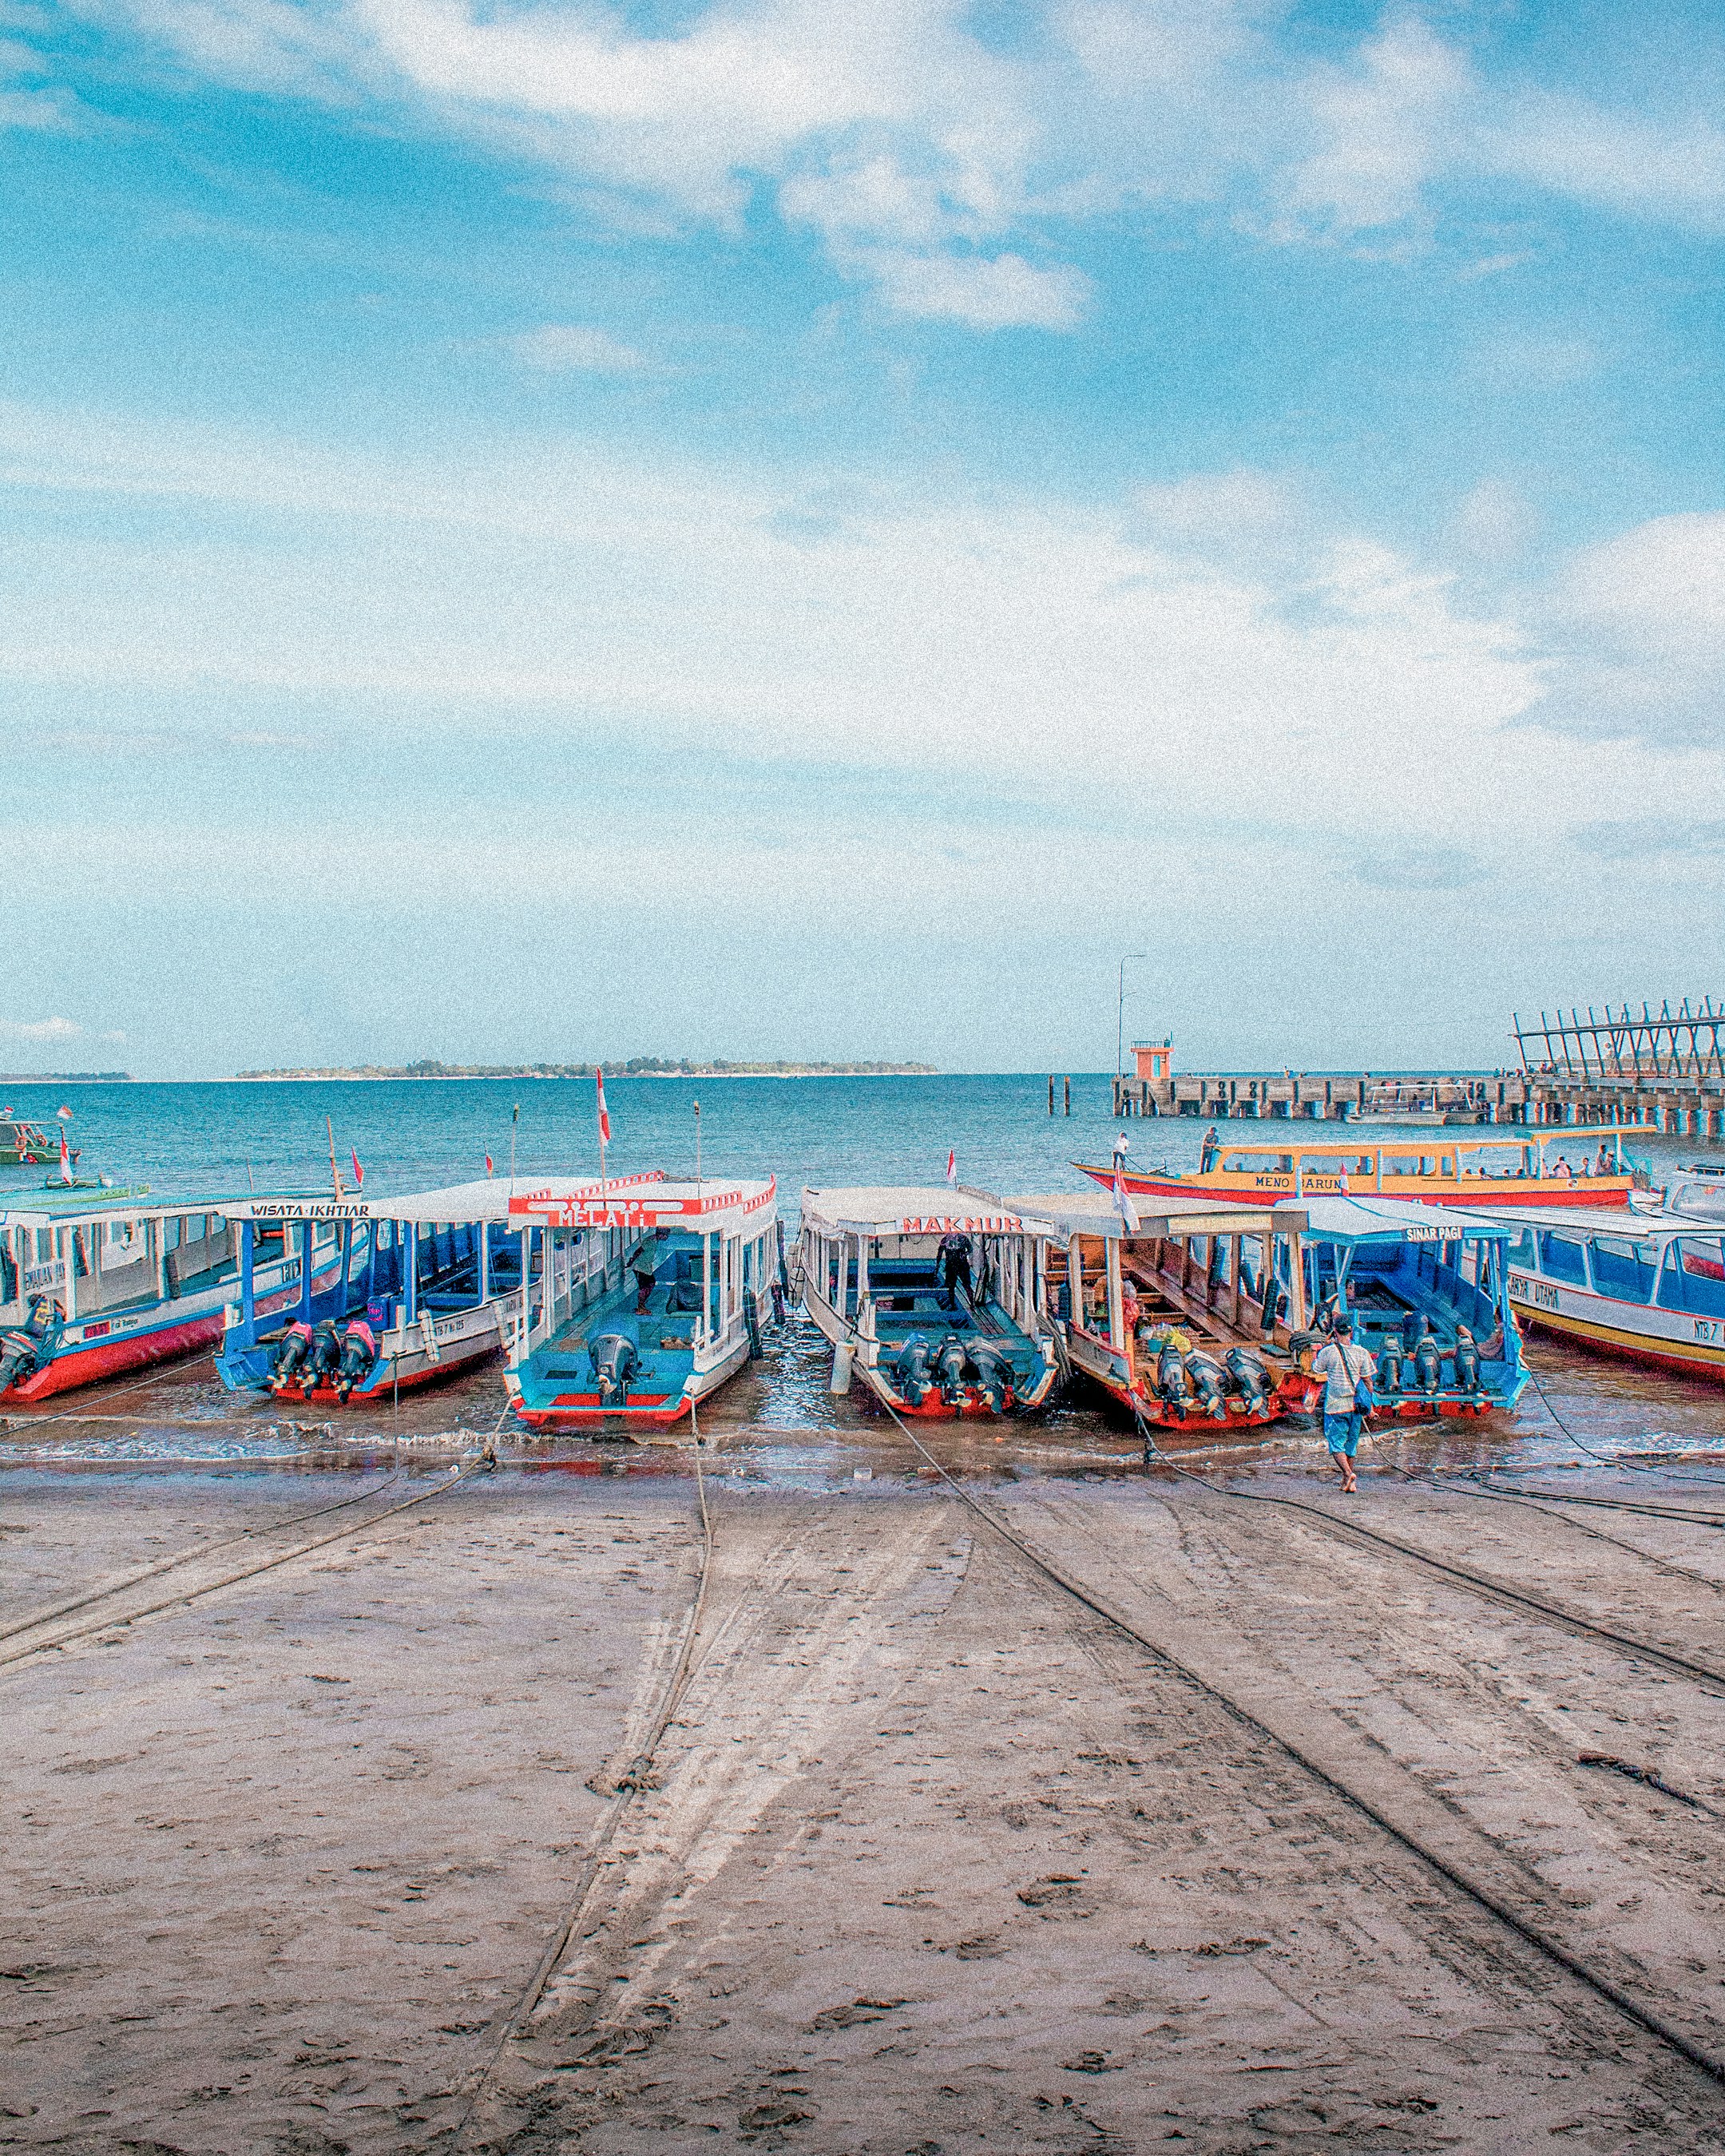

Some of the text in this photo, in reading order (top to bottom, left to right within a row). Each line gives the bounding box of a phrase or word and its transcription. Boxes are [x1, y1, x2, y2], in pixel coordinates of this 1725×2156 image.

[1255, 1176, 1290, 1187] MENO
[252, 1205, 370, 1216] WISATA IKHTIAR
[902, 1216, 1024, 1232] MAKMUR
[1406, 1226, 1462, 1242] SINAR PAGI
[1693, 1319, 1710, 1341] NTB
[1711, 1322, 1719, 1341] 7
